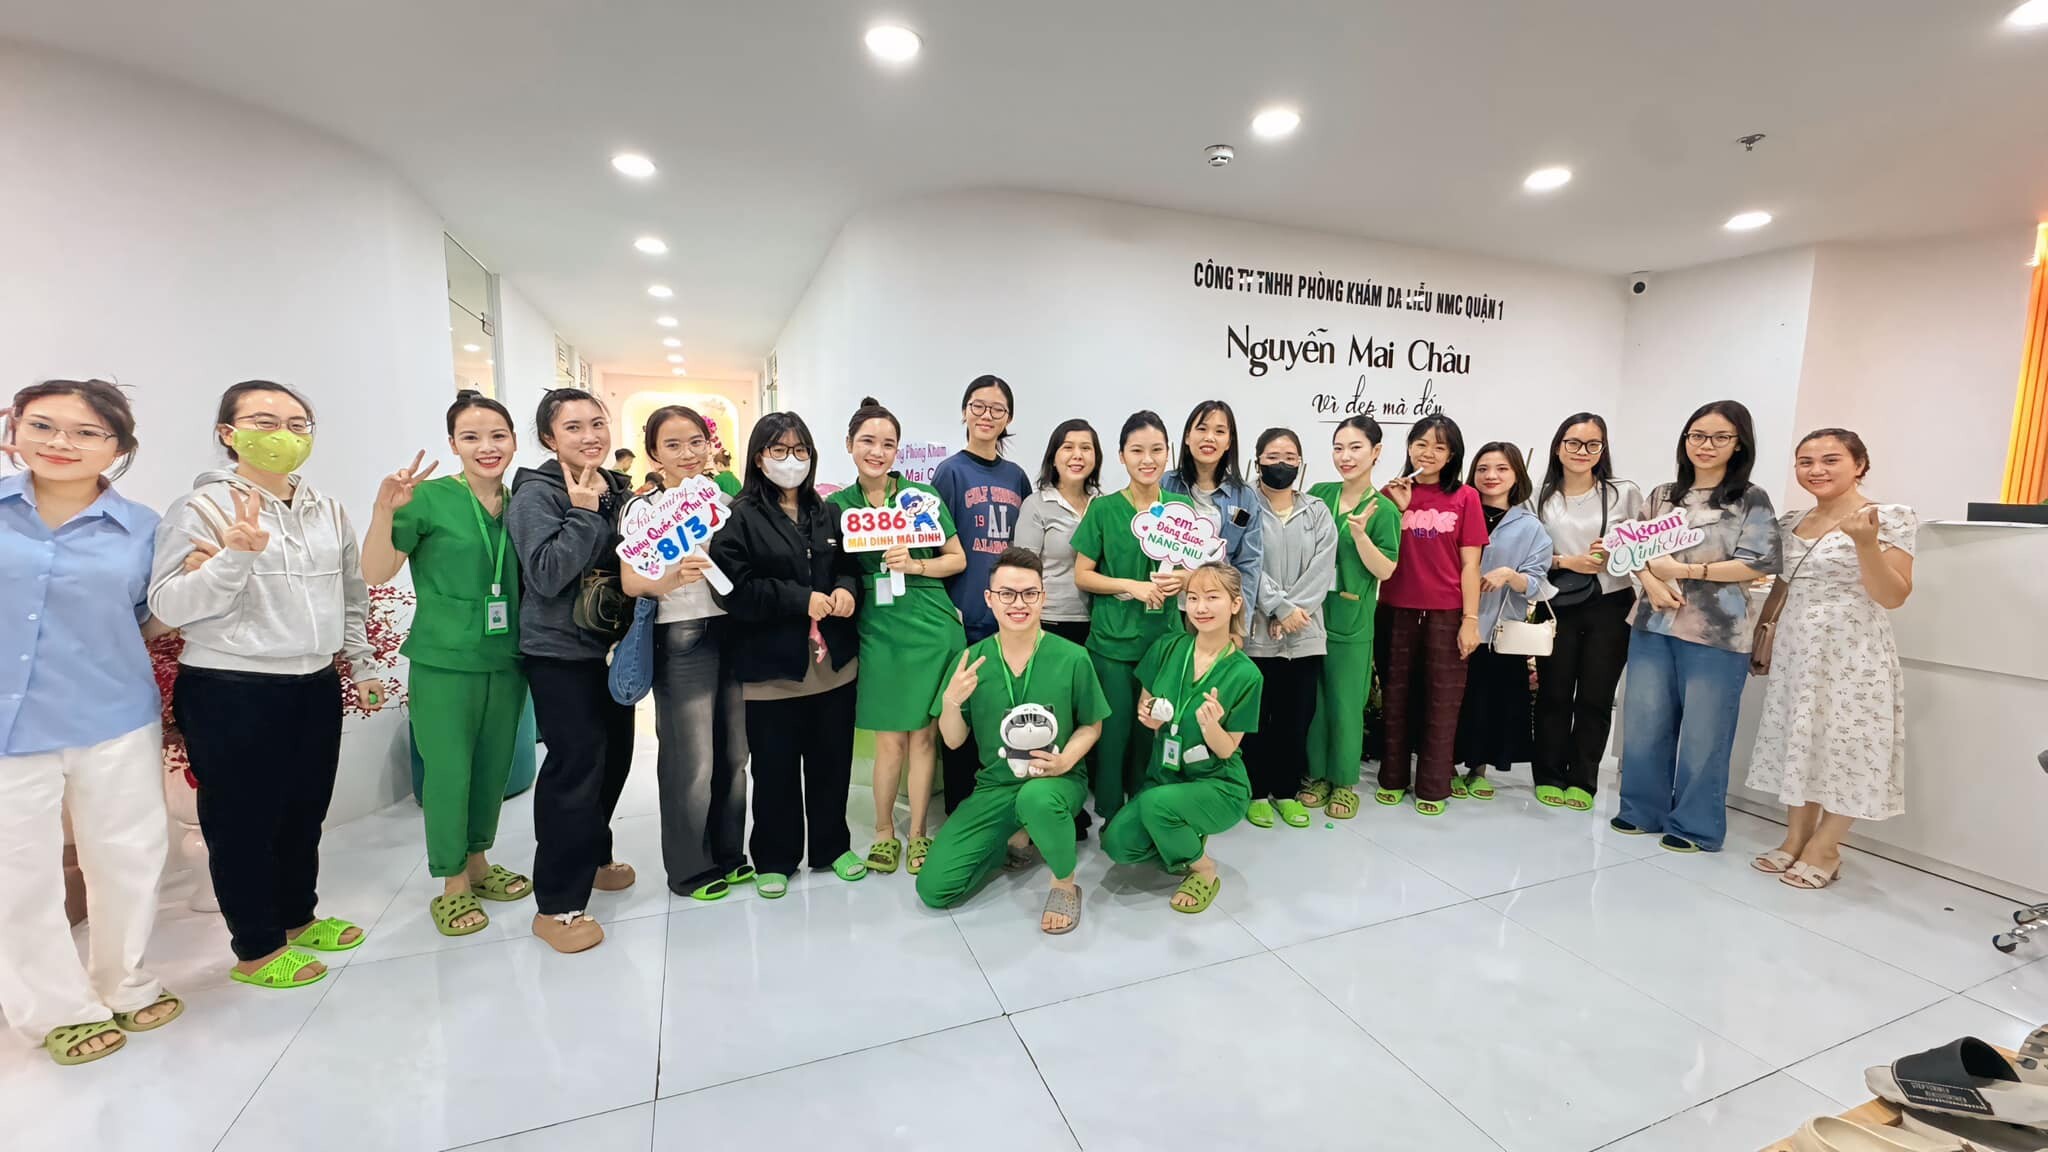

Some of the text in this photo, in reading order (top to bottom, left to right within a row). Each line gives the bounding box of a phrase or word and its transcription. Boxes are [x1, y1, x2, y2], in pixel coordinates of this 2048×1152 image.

[1194, 258, 1504, 324] CÔNG TY TNHH PHÒNG KHÁM DA LIỄU NMC QUẬN 1
[1227, 324, 1471, 377] Nguyễn Mai Châu
[1312, 393, 1339, 414] Vì
[1383, 397, 1408, 415] mà
[1413, 378, 1445, 416] đến
[905, 467, 924, 482] Mai
[622, 538, 650, 560] Ngày
[646, 517, 674, 541] Quốc
[680, 500, 703, 516] Phụ
[698, 487, 716, 503] Nữ
[656, 515, 708, 561] 8/3
[847, 510, 907, 533] 8386
[988, 504, 1011, 539] AL
[1171, 516, 1195, 532] em
[1614, 514, 1684, 545] Ngoan
[1147, 533, 1204, 560] NÂNG NIU
[1610, 538, 1661, 574] Xinh
